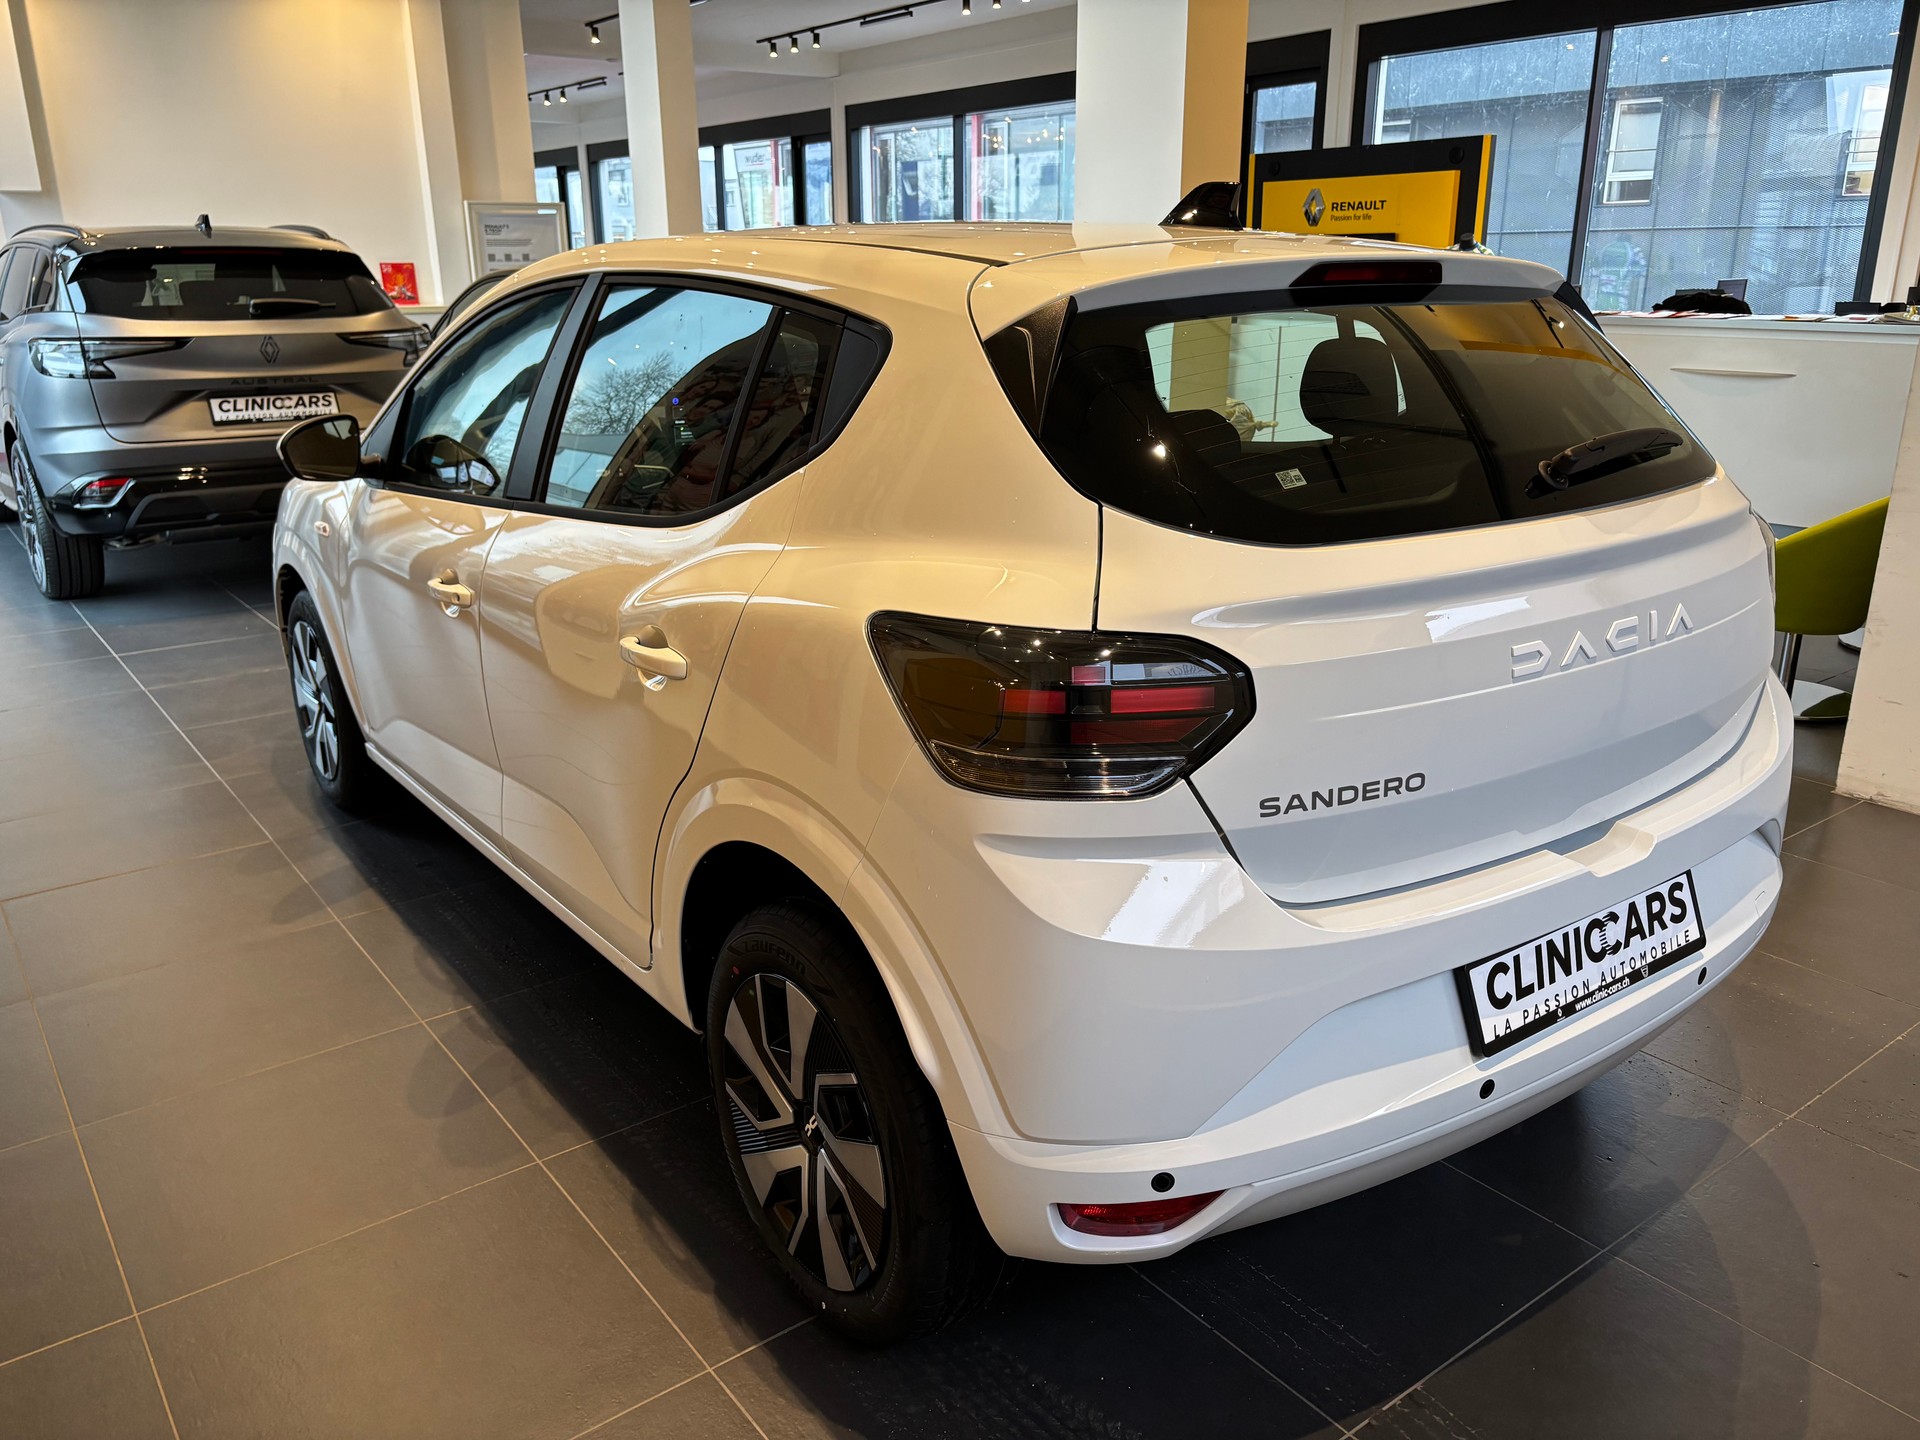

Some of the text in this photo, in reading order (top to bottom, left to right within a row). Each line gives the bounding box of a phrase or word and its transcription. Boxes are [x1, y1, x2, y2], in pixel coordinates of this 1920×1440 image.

[1330, 213, 1372, 222] Passion for life
[1331, 200, 1387, 212] RENAULT
[1511, 603, 1695, 679] DACIA
[1259, 772, 1426, 818] SANDERO
[1493, 928, 1691, 1040] LA PASSION AUTOMOBILE
[1574, 976, 1631, 1012] www.clinic-cars.ch
